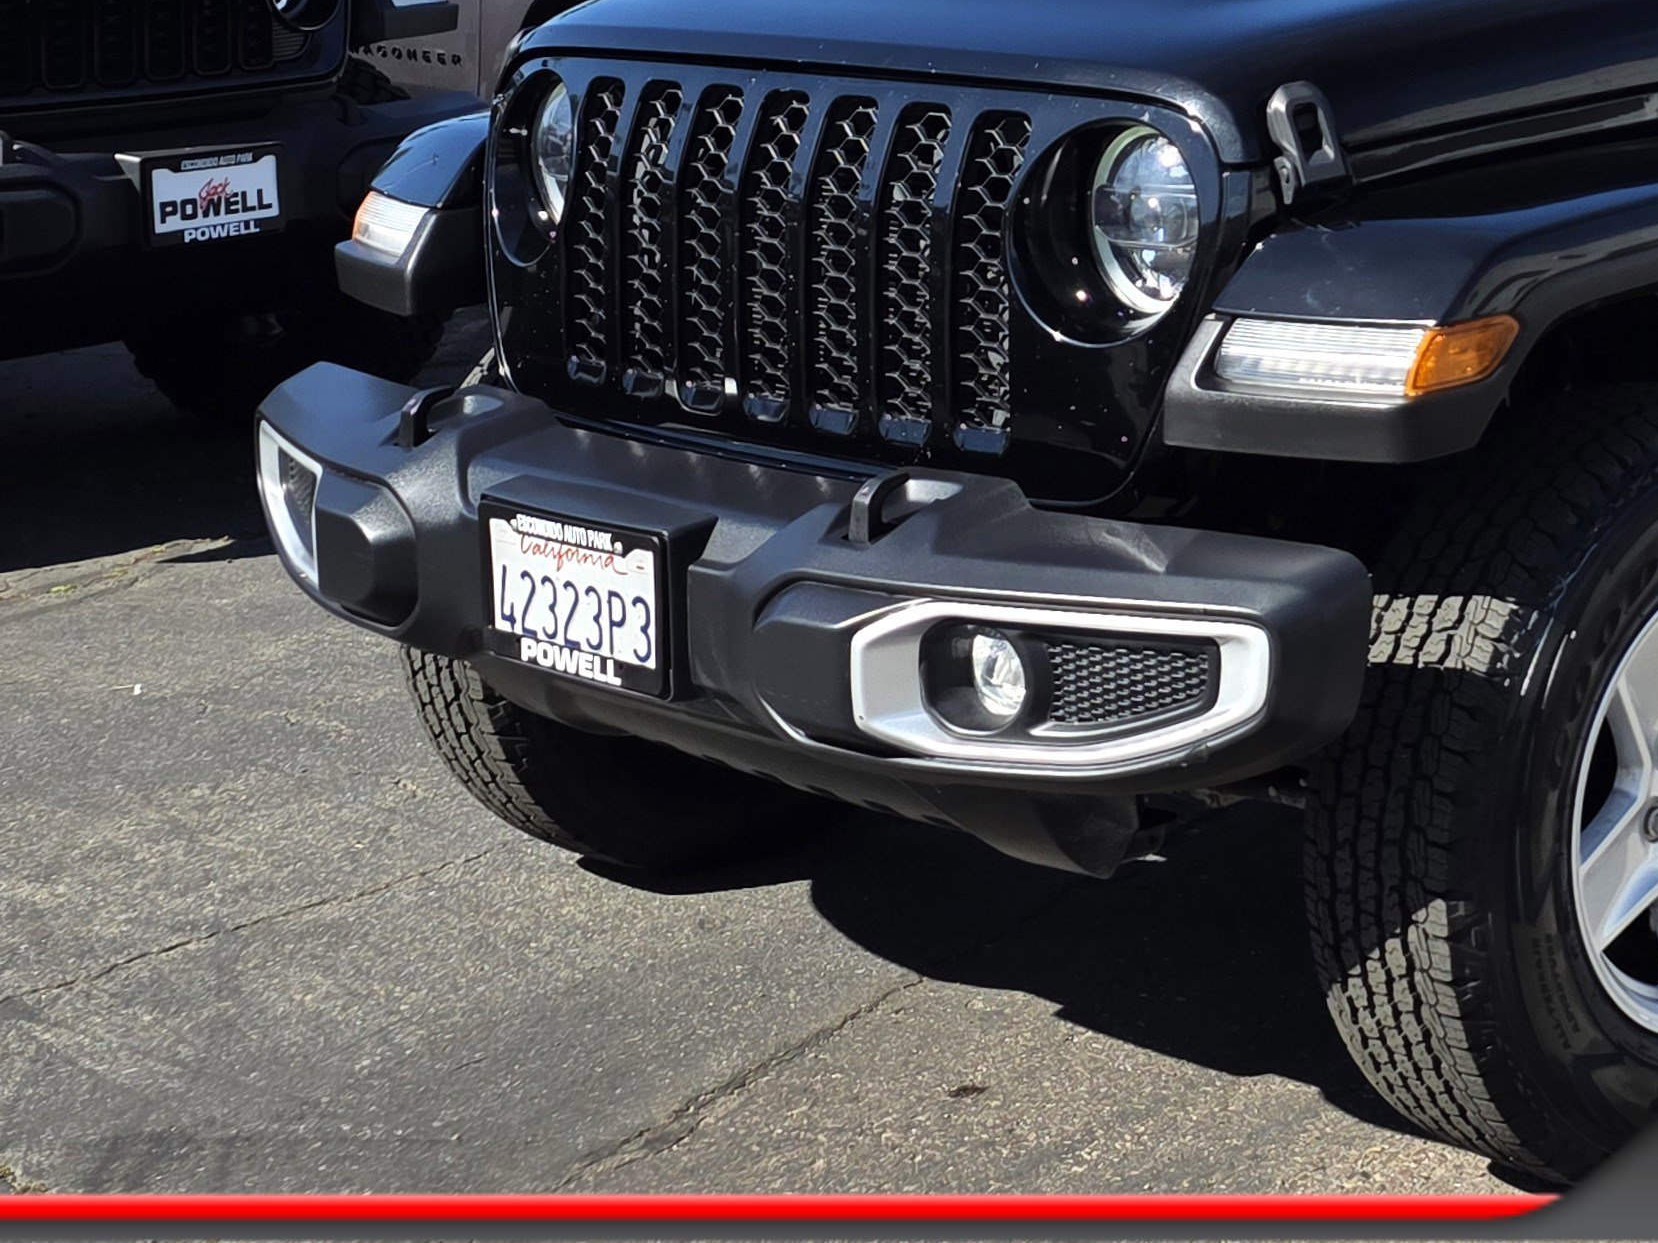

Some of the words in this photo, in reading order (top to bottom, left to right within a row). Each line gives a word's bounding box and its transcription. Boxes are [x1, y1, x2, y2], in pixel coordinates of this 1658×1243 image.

[159, 188, 273, 224] POWELL
[184, 220, 260, 243] POWELL
[501, 564, 652, 662] 42323P3
[521, 637, 622, 686] POWELL
